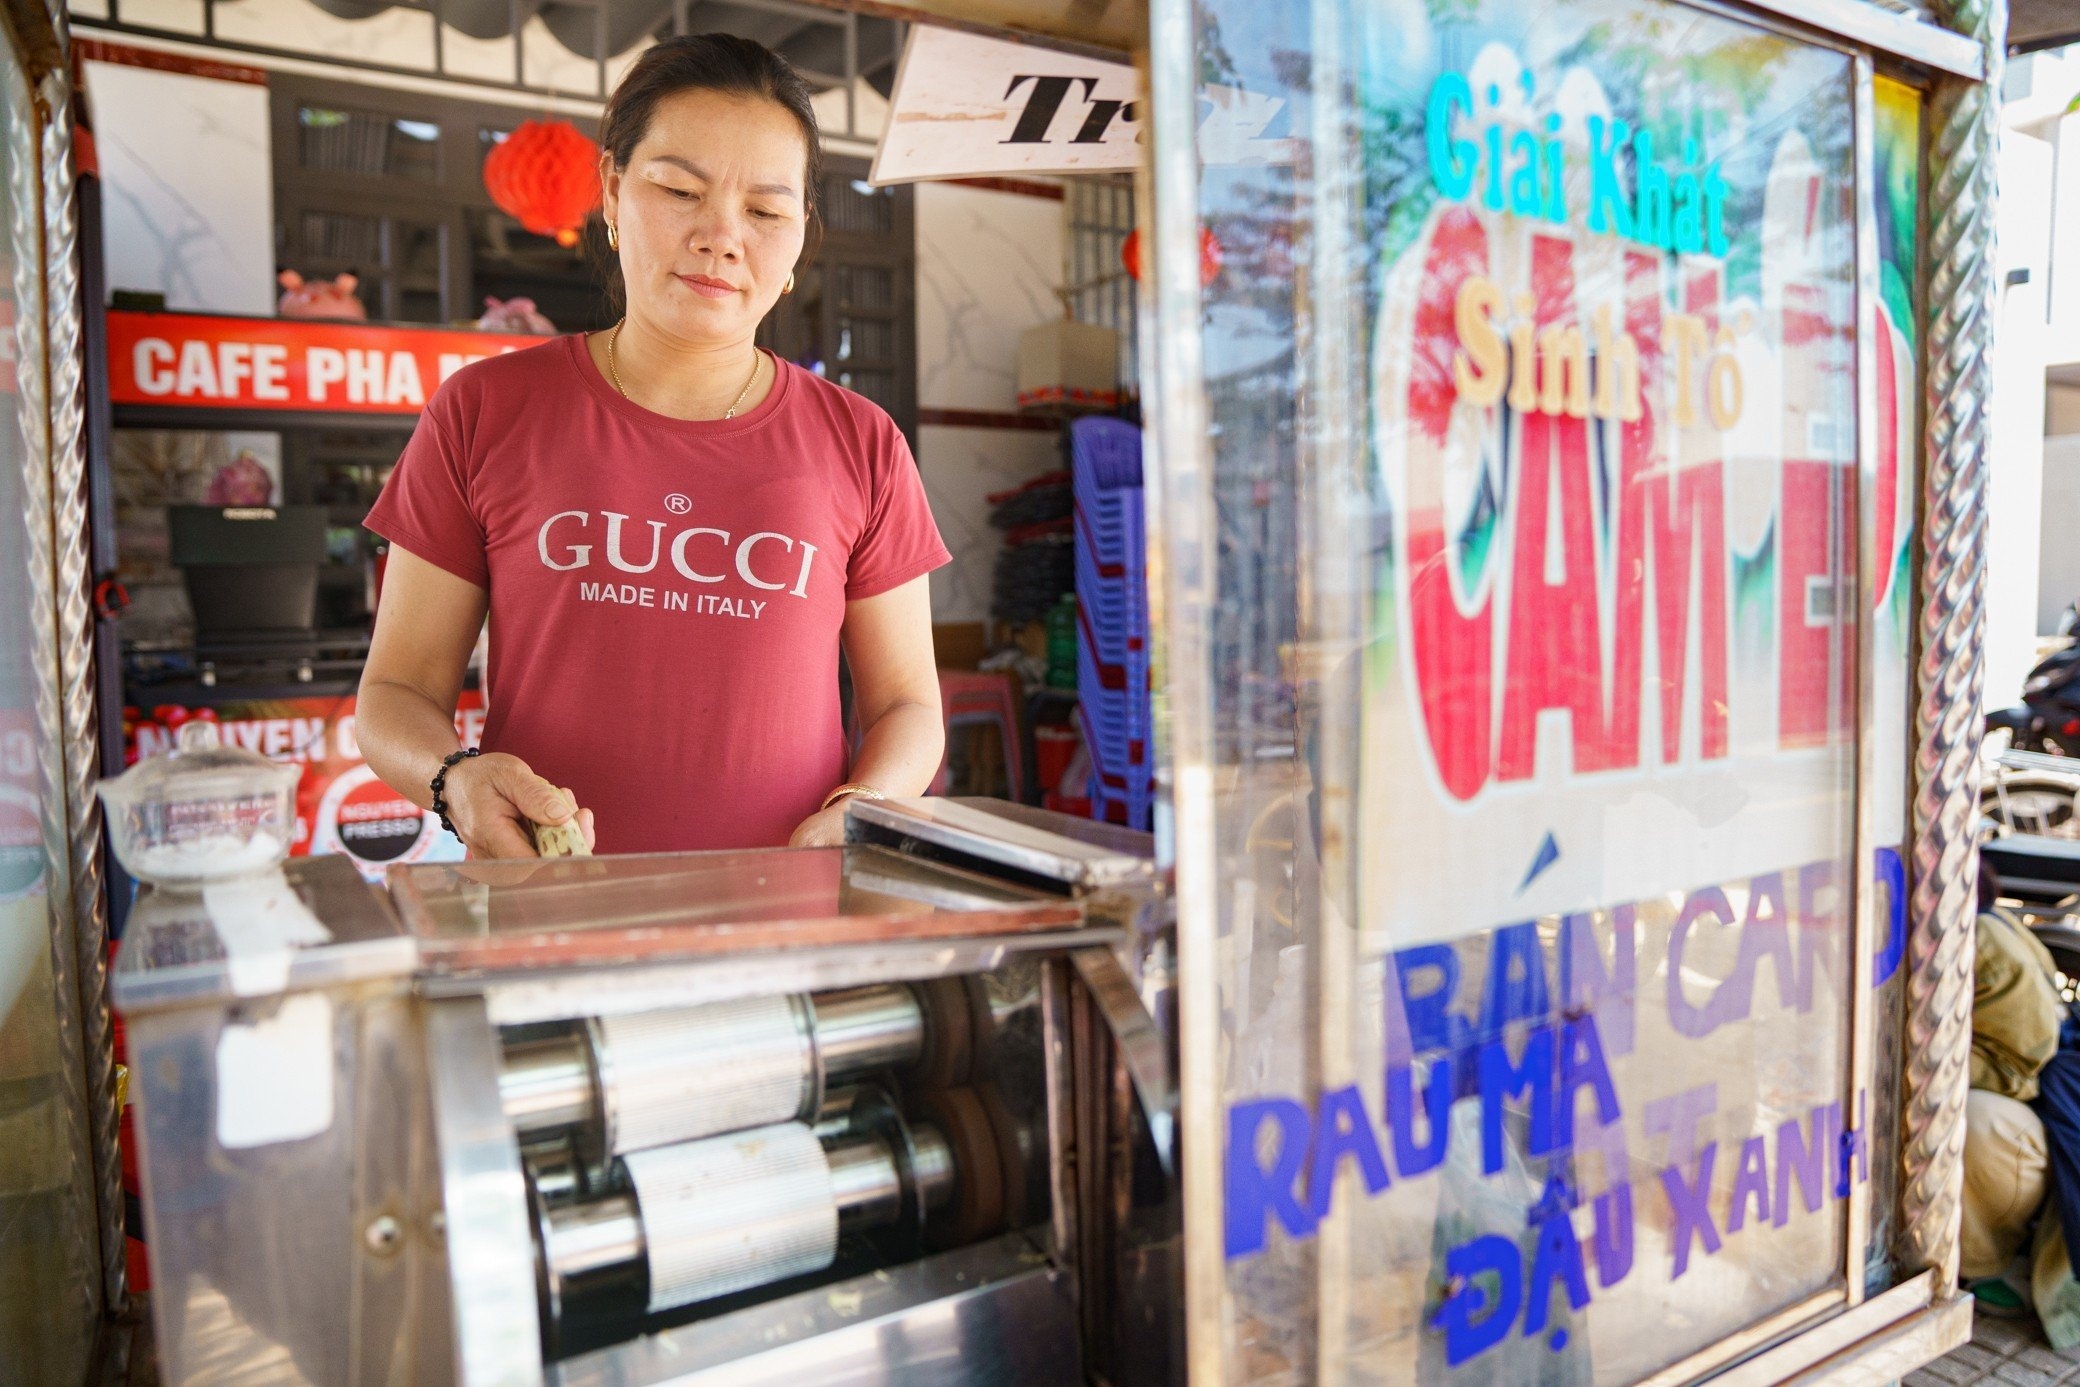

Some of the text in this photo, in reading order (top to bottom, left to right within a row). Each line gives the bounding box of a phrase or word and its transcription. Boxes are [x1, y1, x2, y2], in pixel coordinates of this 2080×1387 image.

[1586, 114, 1730, 258] Khát
[134, 338, 290, 400] CAFE
[307, 346, 425, 405] PHA
[1454, 276, 1642, 422] Sinh
[537, 510, 818, 599] GUCCI
[580, 582, 767, 619] MADE IN ITALY
[342, 817, 421, 841] PRESSO
[1224, 1058, 1451, 1263] RAU
[1660, 1088, 1867, 1282] XANH
